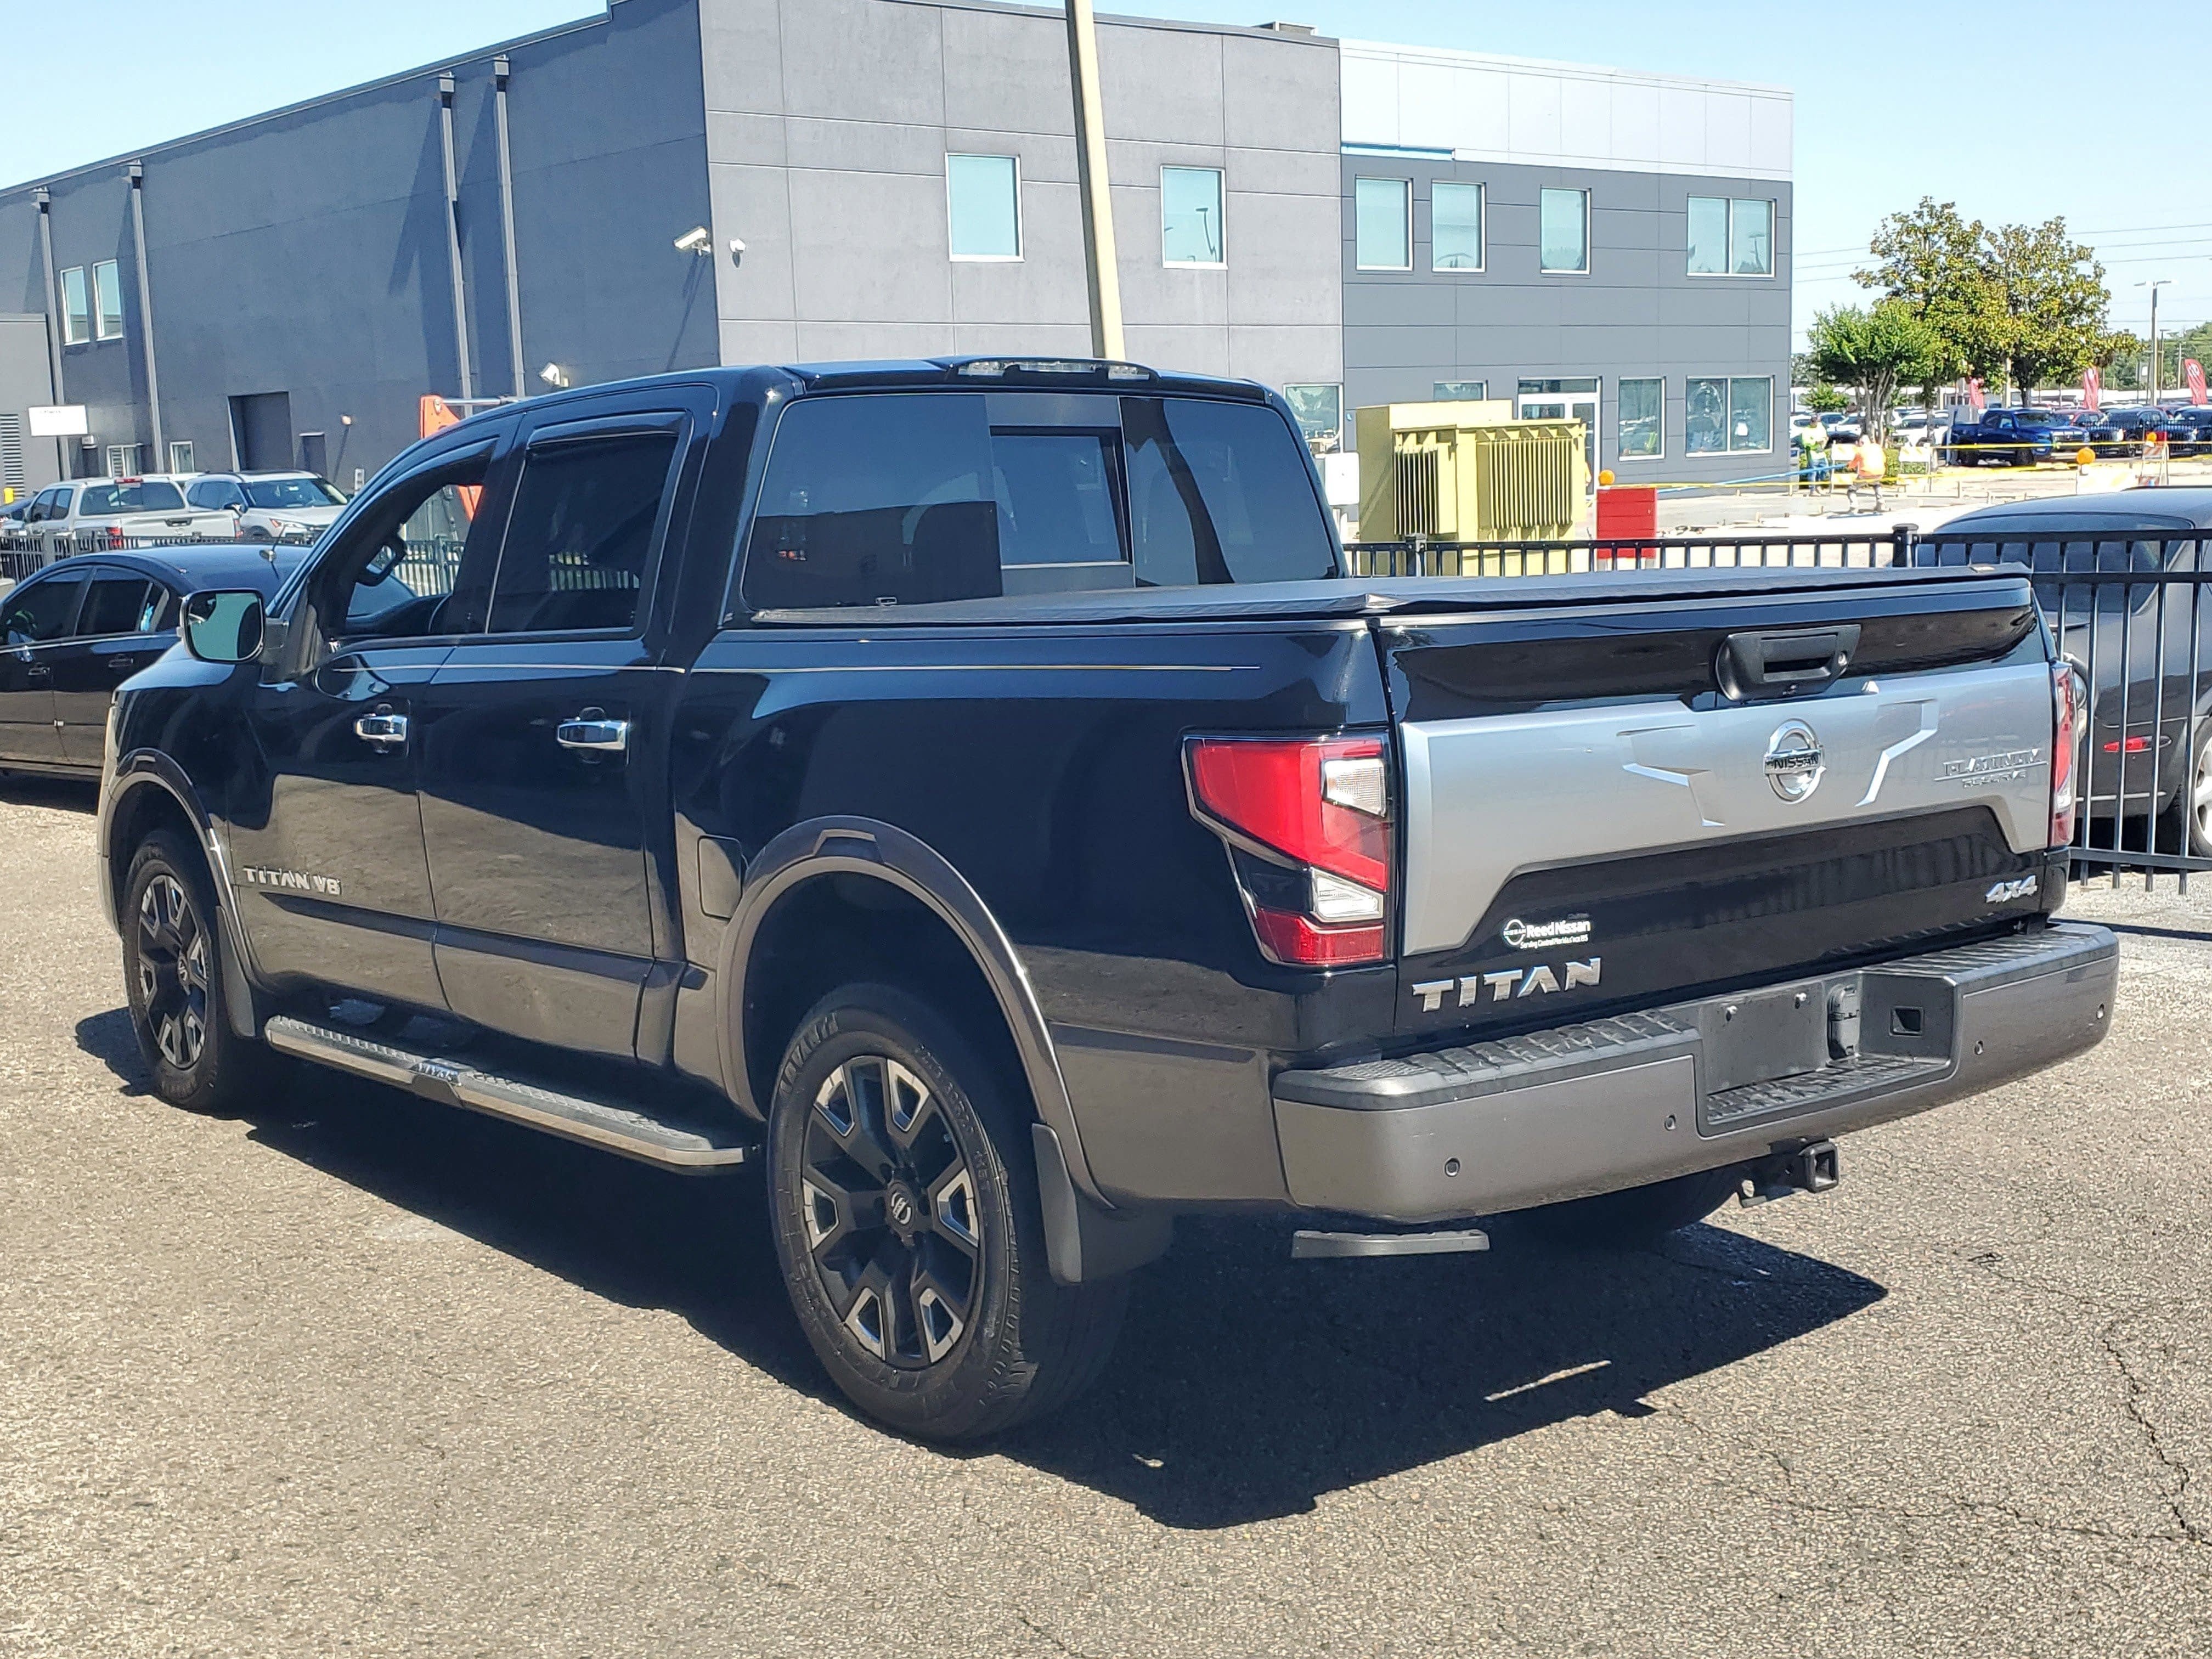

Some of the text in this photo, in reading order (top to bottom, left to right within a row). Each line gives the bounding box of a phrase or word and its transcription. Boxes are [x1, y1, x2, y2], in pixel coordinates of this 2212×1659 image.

[1774, 755, 1819, 769] NISSAN
[244, 867, 341, 895] TITAN V8
[1526, 921, 1590, 938] Reed Nissan
[1412, 957, 1601, 1012] TITAN
